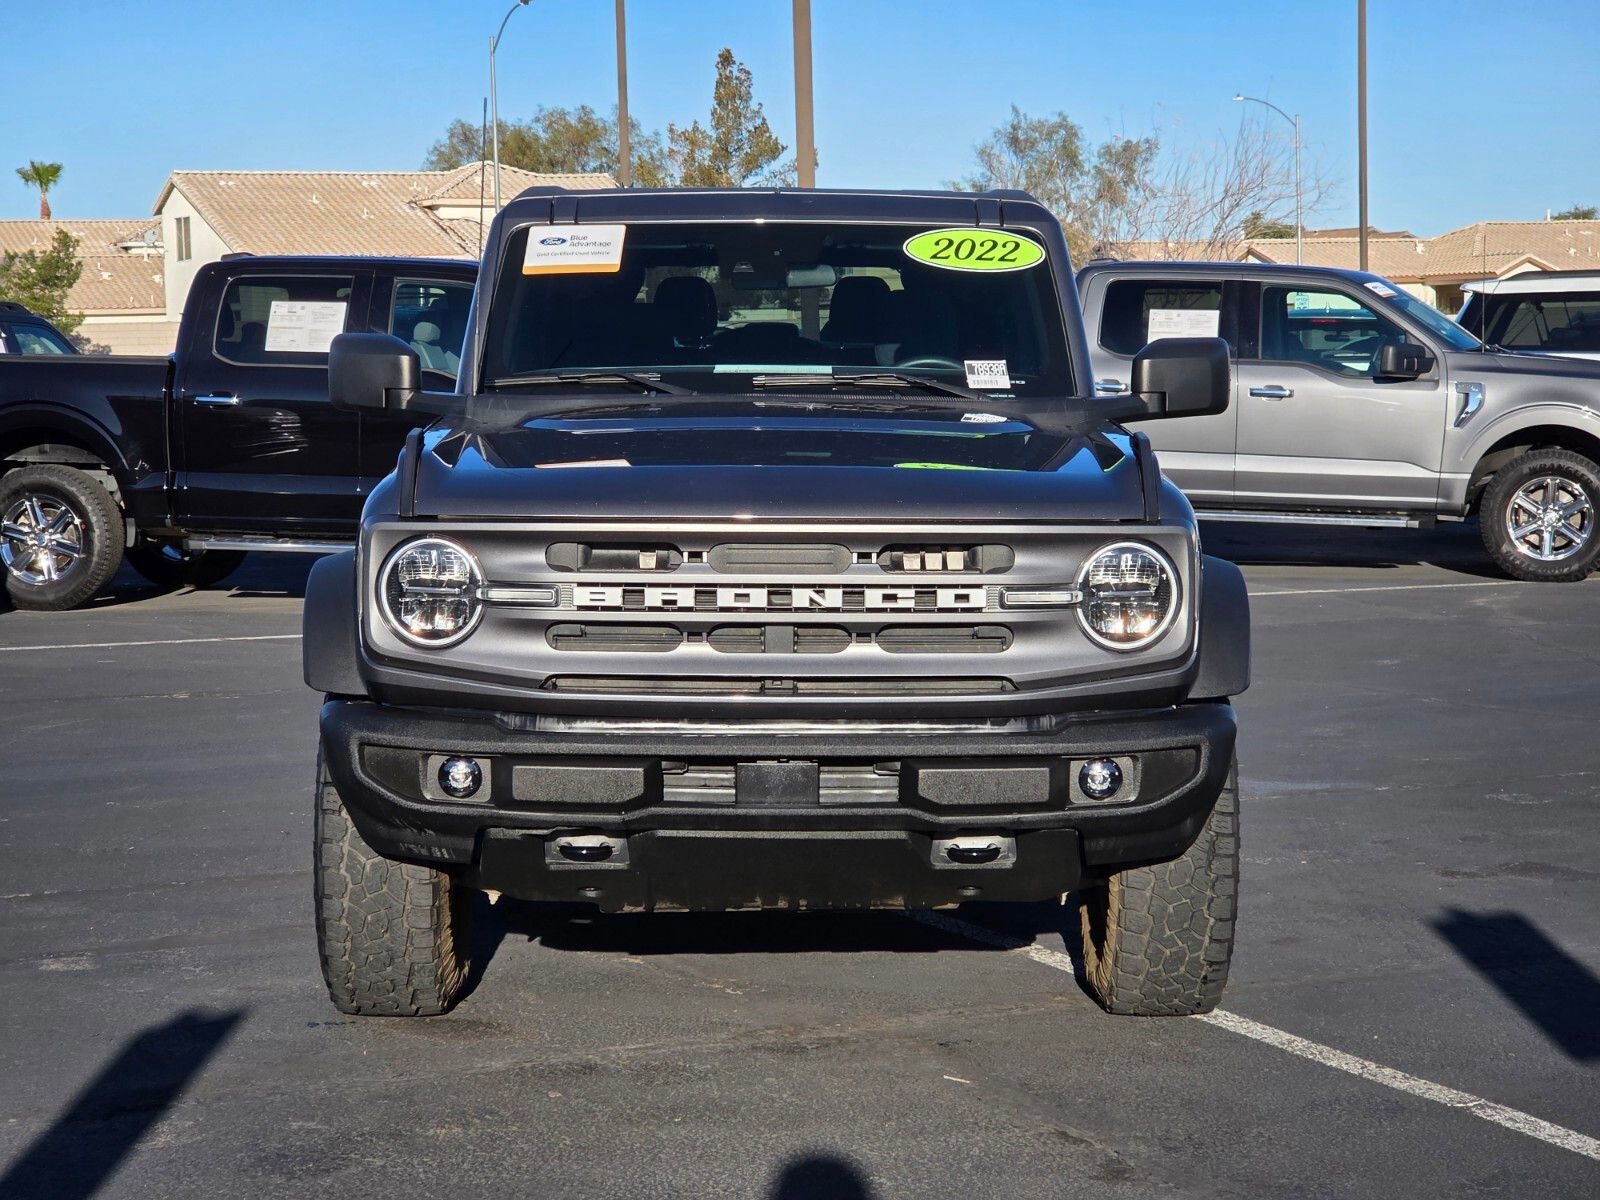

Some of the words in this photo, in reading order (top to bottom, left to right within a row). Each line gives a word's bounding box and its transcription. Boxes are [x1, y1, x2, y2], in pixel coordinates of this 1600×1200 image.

[569, 240, 612, 248] Advantage
[930, 238, 1020, 262] 2022
[572, 587, 987, 608] BRONCO
